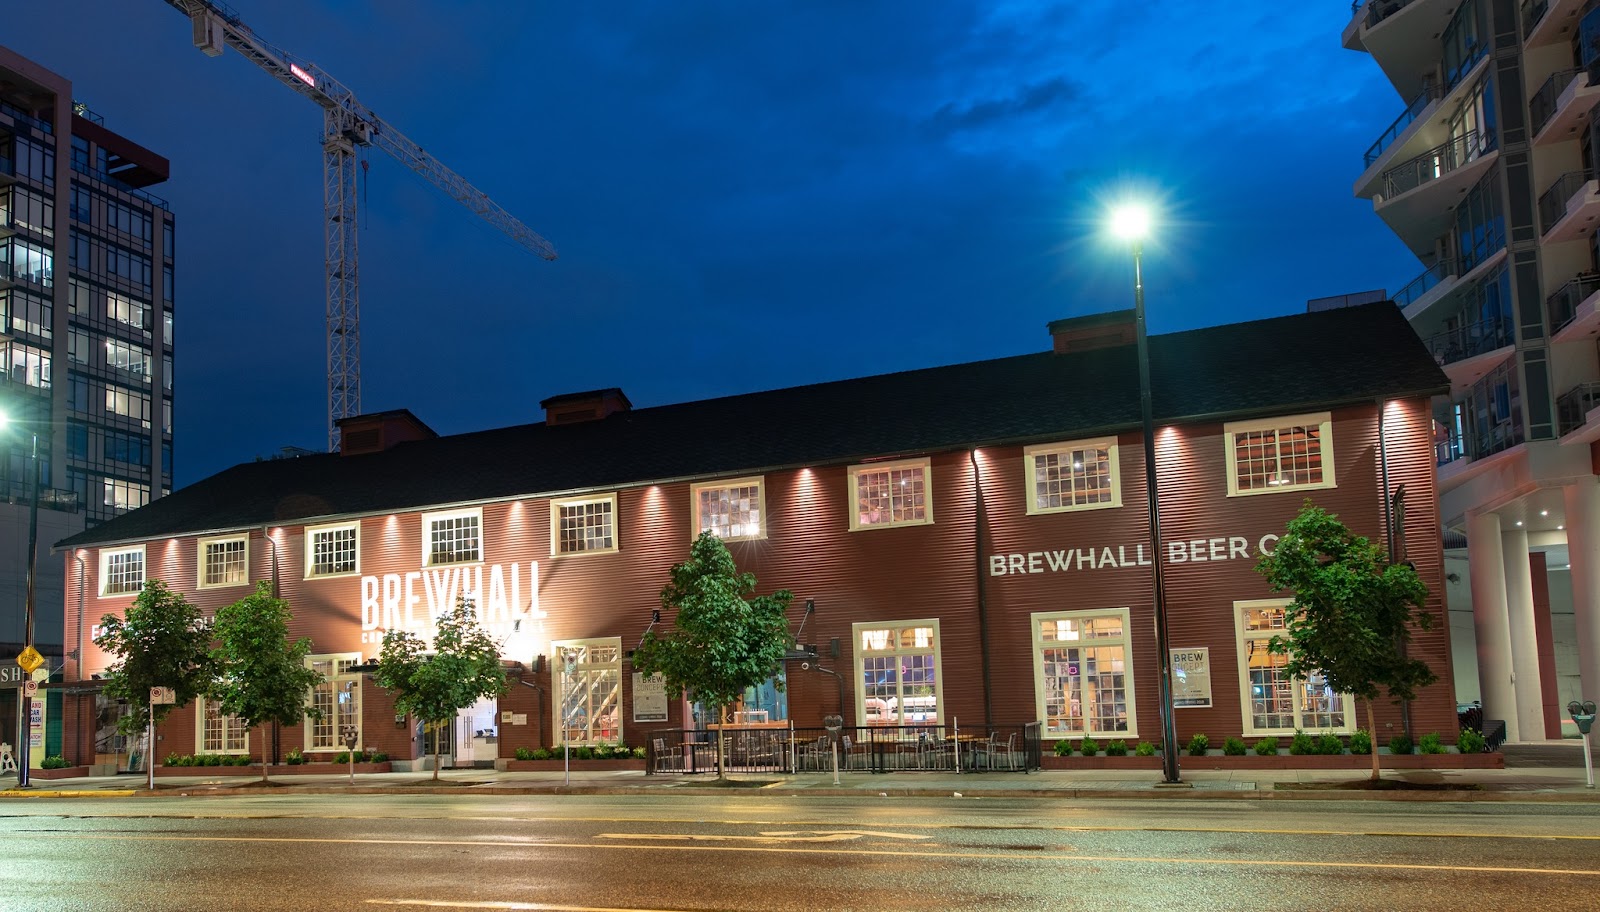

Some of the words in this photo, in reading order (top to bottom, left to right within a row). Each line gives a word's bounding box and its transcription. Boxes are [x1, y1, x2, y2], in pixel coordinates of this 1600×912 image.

[990, 543, 1152, 577] BREWHALL
[1168, 536, 1250, 563] BEER
[361, 560, 547, 631] BREWHALL
[1174, 653, 1204, 662] BREW
[642, 675, 663, 683] BREW
